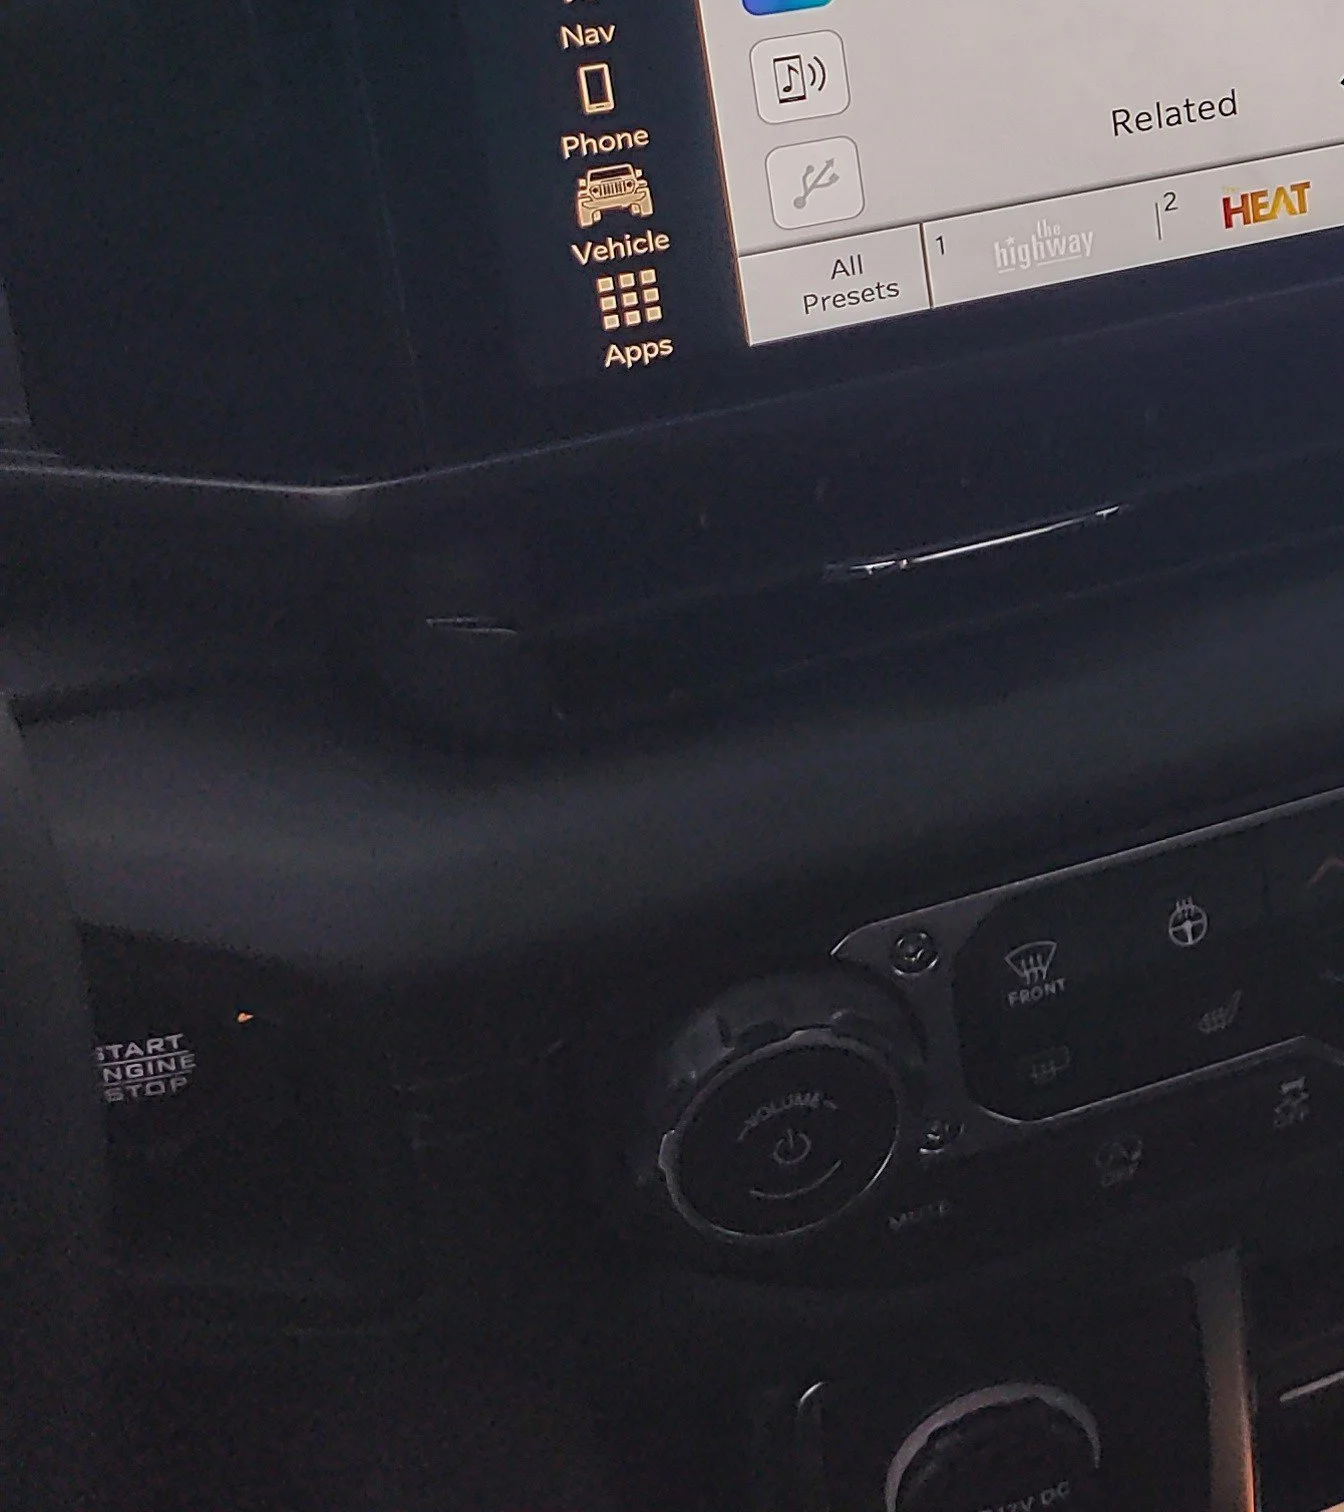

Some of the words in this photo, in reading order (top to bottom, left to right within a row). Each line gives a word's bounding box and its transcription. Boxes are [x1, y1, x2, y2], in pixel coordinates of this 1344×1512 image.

[560, 19, 616, 50] Nav
[1111, 90, 1239, 136] Related
[561, 124, 650, 161] Phone
[1163, 192, 1178, 212] 2
[1222, 181, 1311, 229] HEAT
[571, 226, 671, 268] Vehicle
[936, 236, 947, 257] 1
[994, 228, 1095, 272] highway
[830, 254, 865, 279] All
[802, 278, 900, 314] Presets
[602, 334, 674, 370] Apps
[1007, 978, 1066, 1006] FRONT
[102, 1053, 197, 1083] NGINE
[103, 1076, 188, 1102] STOP
